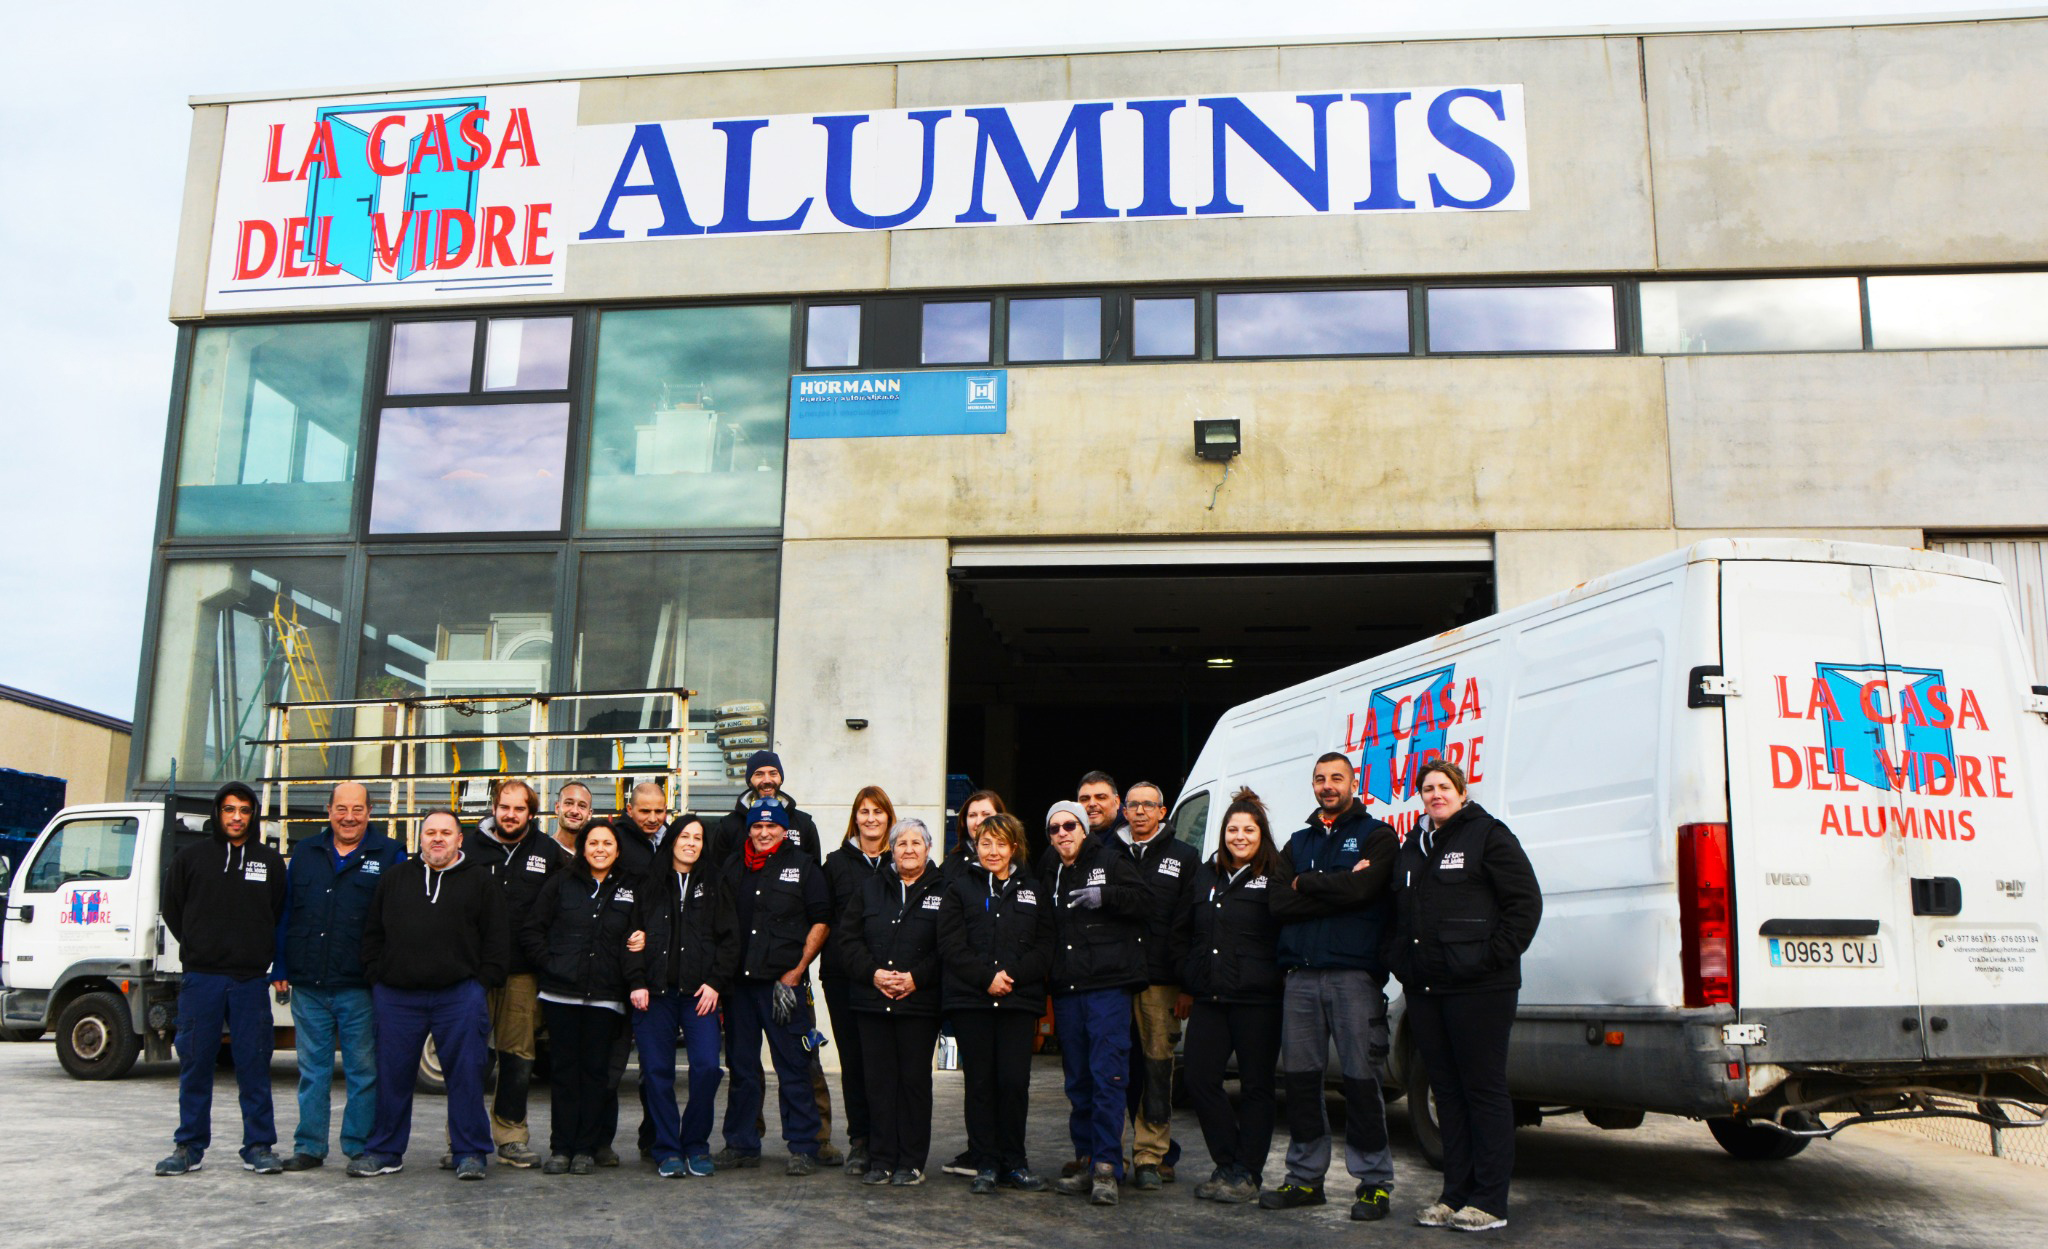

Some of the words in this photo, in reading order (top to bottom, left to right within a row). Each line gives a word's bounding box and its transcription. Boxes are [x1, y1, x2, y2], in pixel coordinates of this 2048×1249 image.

[261, 120, 342, 183] LA
[366, 107, 541, 177] CASA
[579, 87, 1515, 240] ALUMINIS
[232, 215, 343, 281] DEL
[370, 203, 554, 274] VIDRE
[800, 379, 900, 395] HÖRMANN
[1344, 707, 1380, 754] LA
[1391, 676, 1482, 740] CASA
[1773, 674, 1845, 722] LA
[1859, 679, 1990, 732] CASA
[1768, 744, 1860, 792] DEL
[1874, 748, 2014, 799] VIDRE
[82, 892, 109, 904] CASA
[1765, 872, 1811, 886] IVECO
[1995, 879, 2027, 892] Daily
[1784, 941, 1834, 963] 0963
[1842, 942, 1878, 964] CVJ
[1944, 934, 1956, 943] Tel.
[1957, 935, 1969, 943] 977
[1971, 935, 1983, 943] 863
[2001, 935, 2013, 943] 676
[2027, 935, 2039, 943] 184
